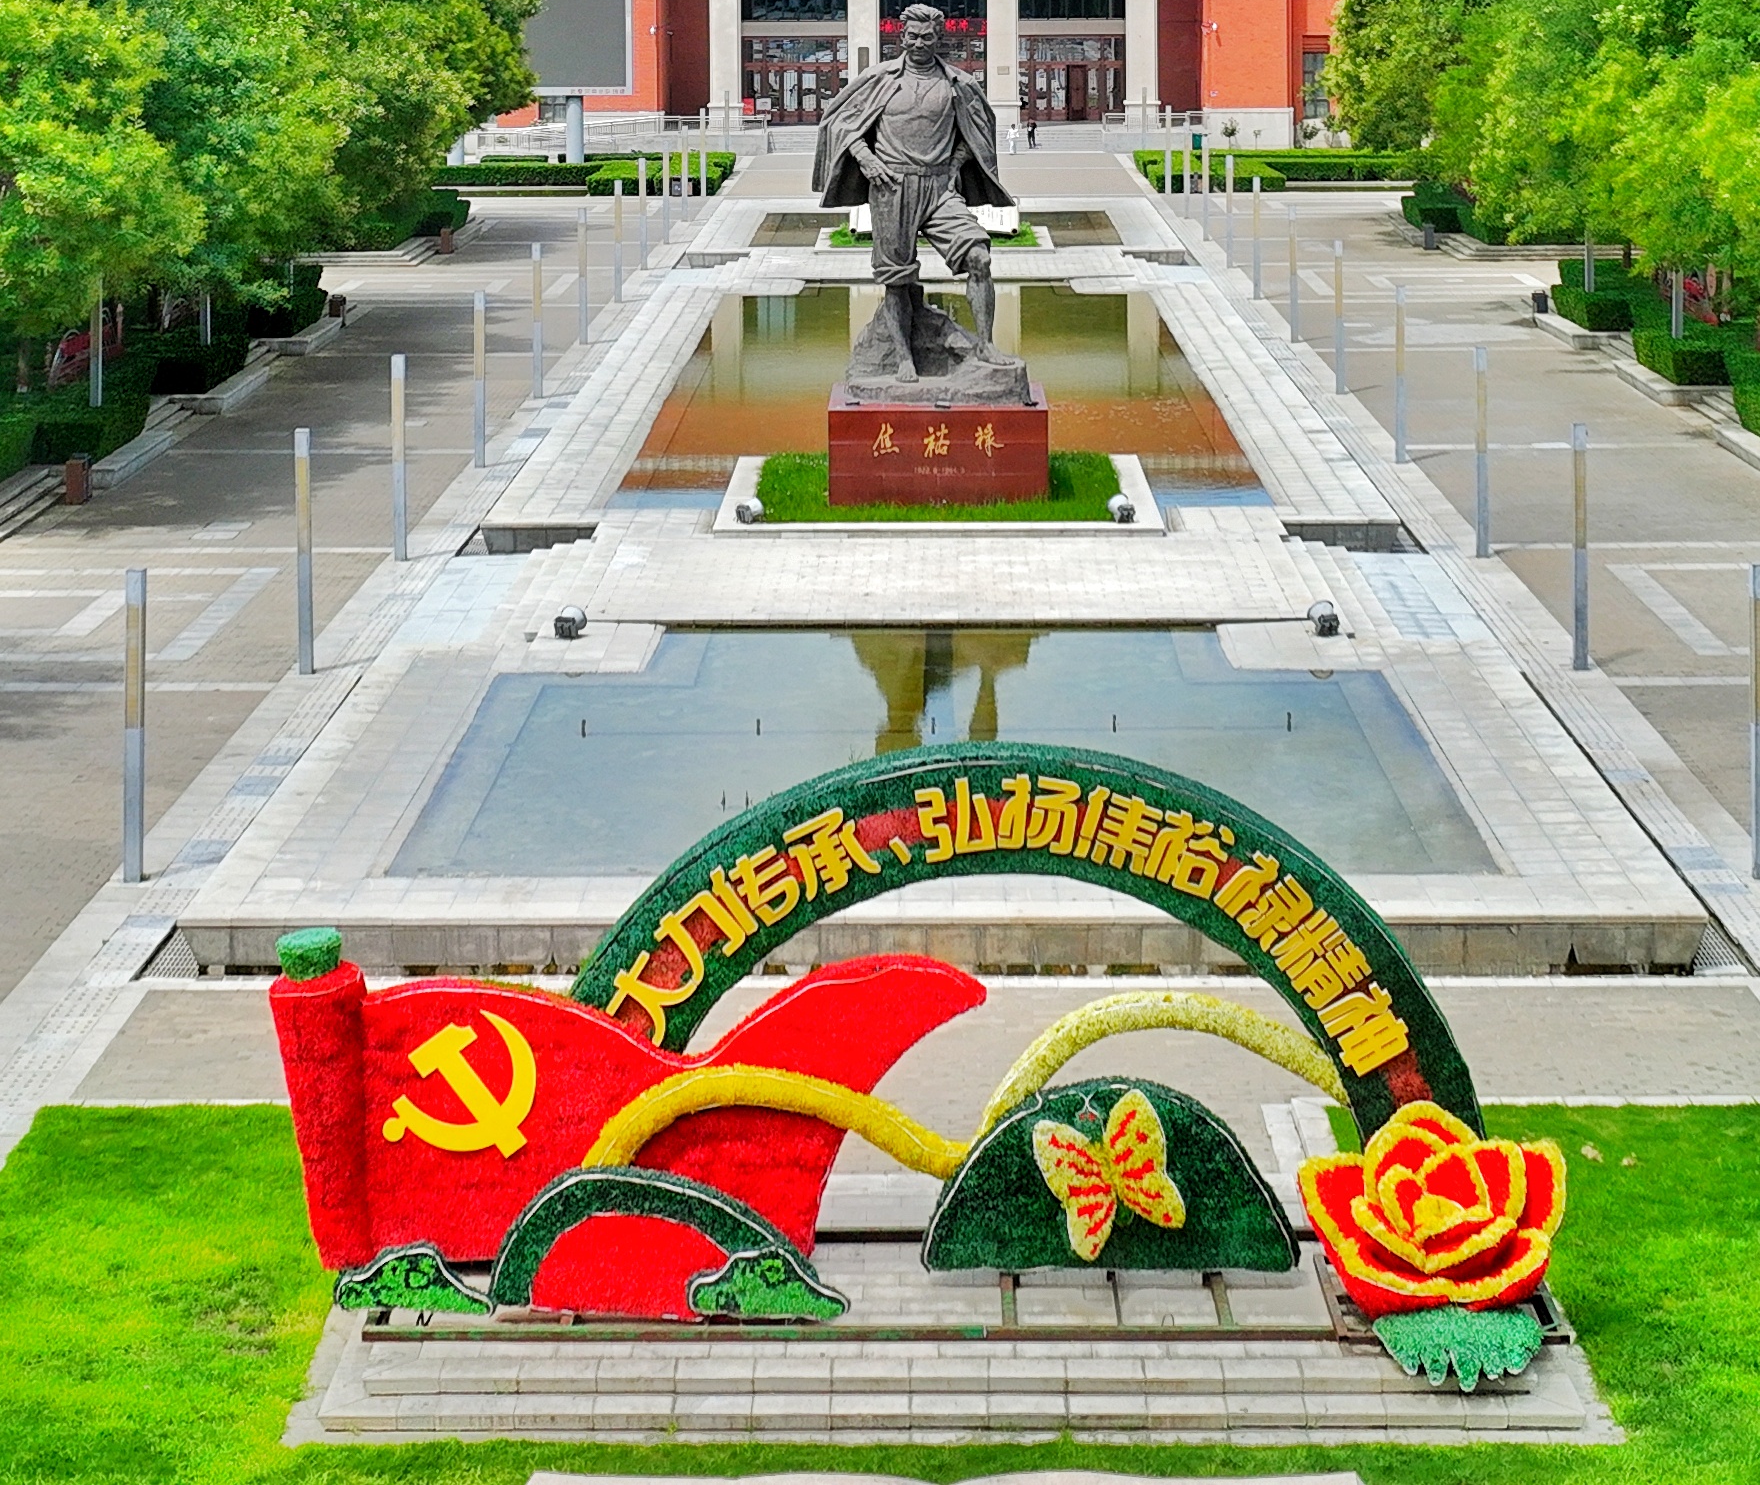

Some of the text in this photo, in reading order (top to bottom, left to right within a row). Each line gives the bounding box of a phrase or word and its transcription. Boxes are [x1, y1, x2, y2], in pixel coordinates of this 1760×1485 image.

[872, 422, 1005, 459] 焦裕禄
[606, 772, 1410, 1078] 大力传承、弘扬焦裕禄精神
